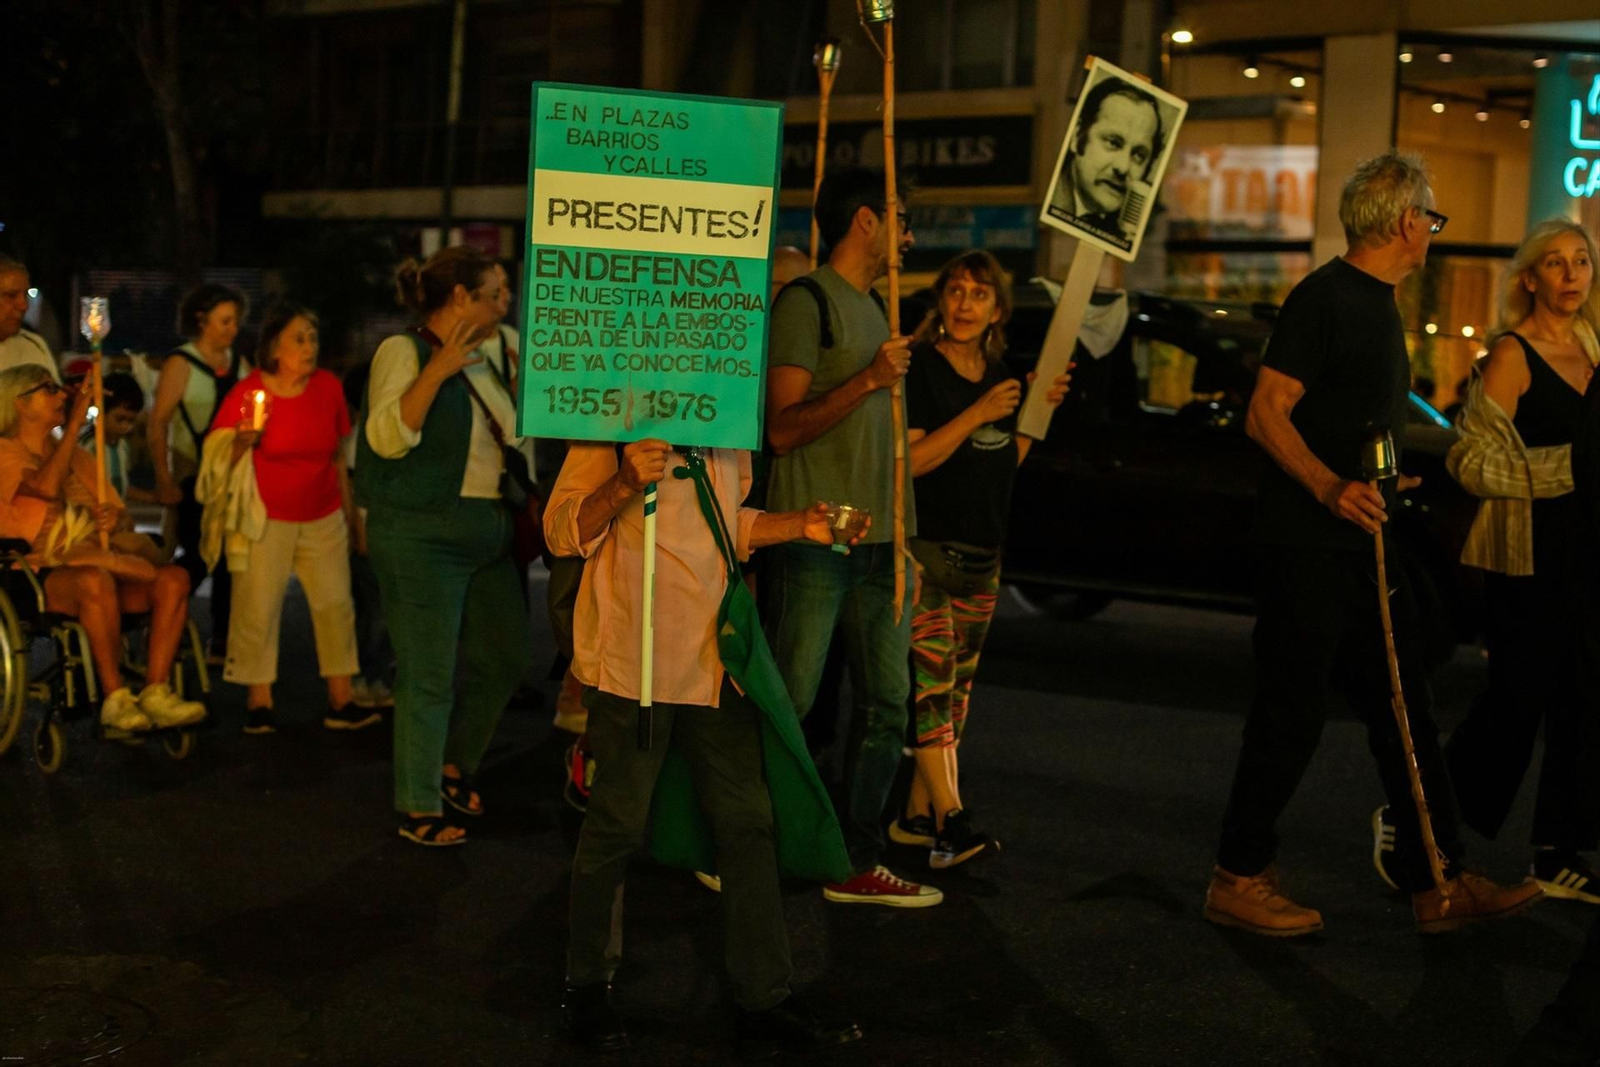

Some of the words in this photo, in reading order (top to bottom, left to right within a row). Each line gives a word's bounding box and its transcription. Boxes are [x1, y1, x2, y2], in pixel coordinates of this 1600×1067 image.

[601, 106, 690, 131] PLAZAS
[566, 127, 660, 151] BARRIOS
[603, 154, 617, 172] Y
[619, 154, 708, 177] CALLES
[547, 197, 766, 240] PRESENTES!
[535, 283, 565, 303] DE
[570, 285, 665, 308] NUESTRA
[669, 290, 765, 313] MEMORIA
[534, 306, 617, 329] FRENTE
[621, 312, 638, 330] A
[642, 312, 671, 330] LA
[675, 312, 757, 333] EMBOS-
[531, 329, 594, 348] CADA
[599, 329, 628, 348] DE
[631, 330, 660, 349] UN
[664, 331, 748, 351] PASADO
[531, 352, 577, 372] QUE
[580, 353, 606, 372] YA
[543, 384, 622, 417] 1955
[643, 389, 718, 423] 1976
